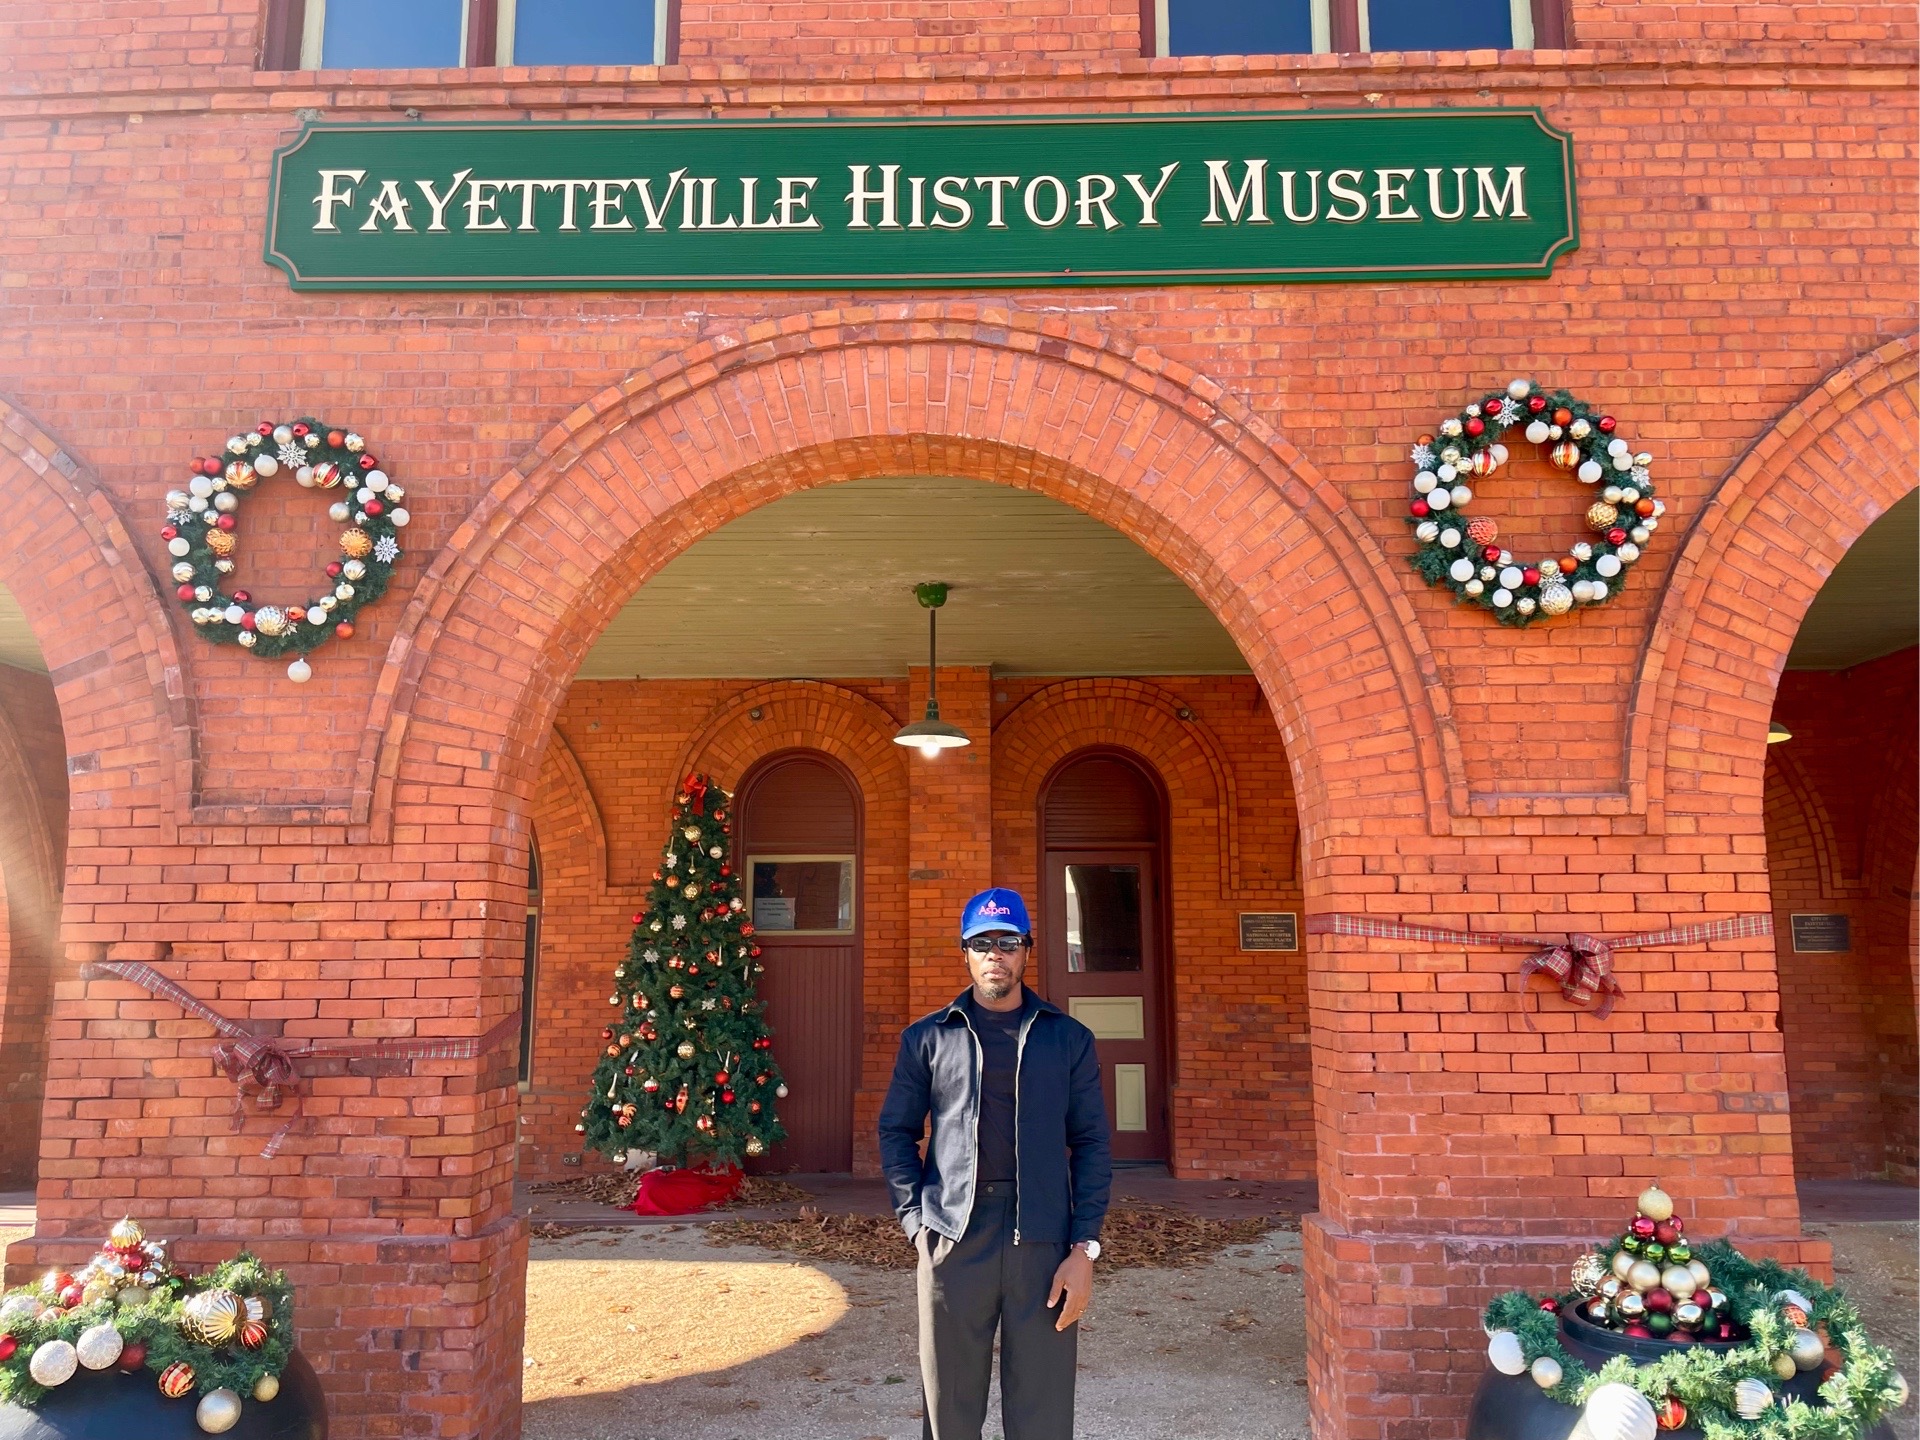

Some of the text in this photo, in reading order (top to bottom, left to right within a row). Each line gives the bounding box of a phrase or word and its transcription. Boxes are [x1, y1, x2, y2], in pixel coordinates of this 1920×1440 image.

[311, 160, 1528, 231] FAYETTEVILLE HISTORY MUSEUM
[978, 905, 1011, 917] Aspen
